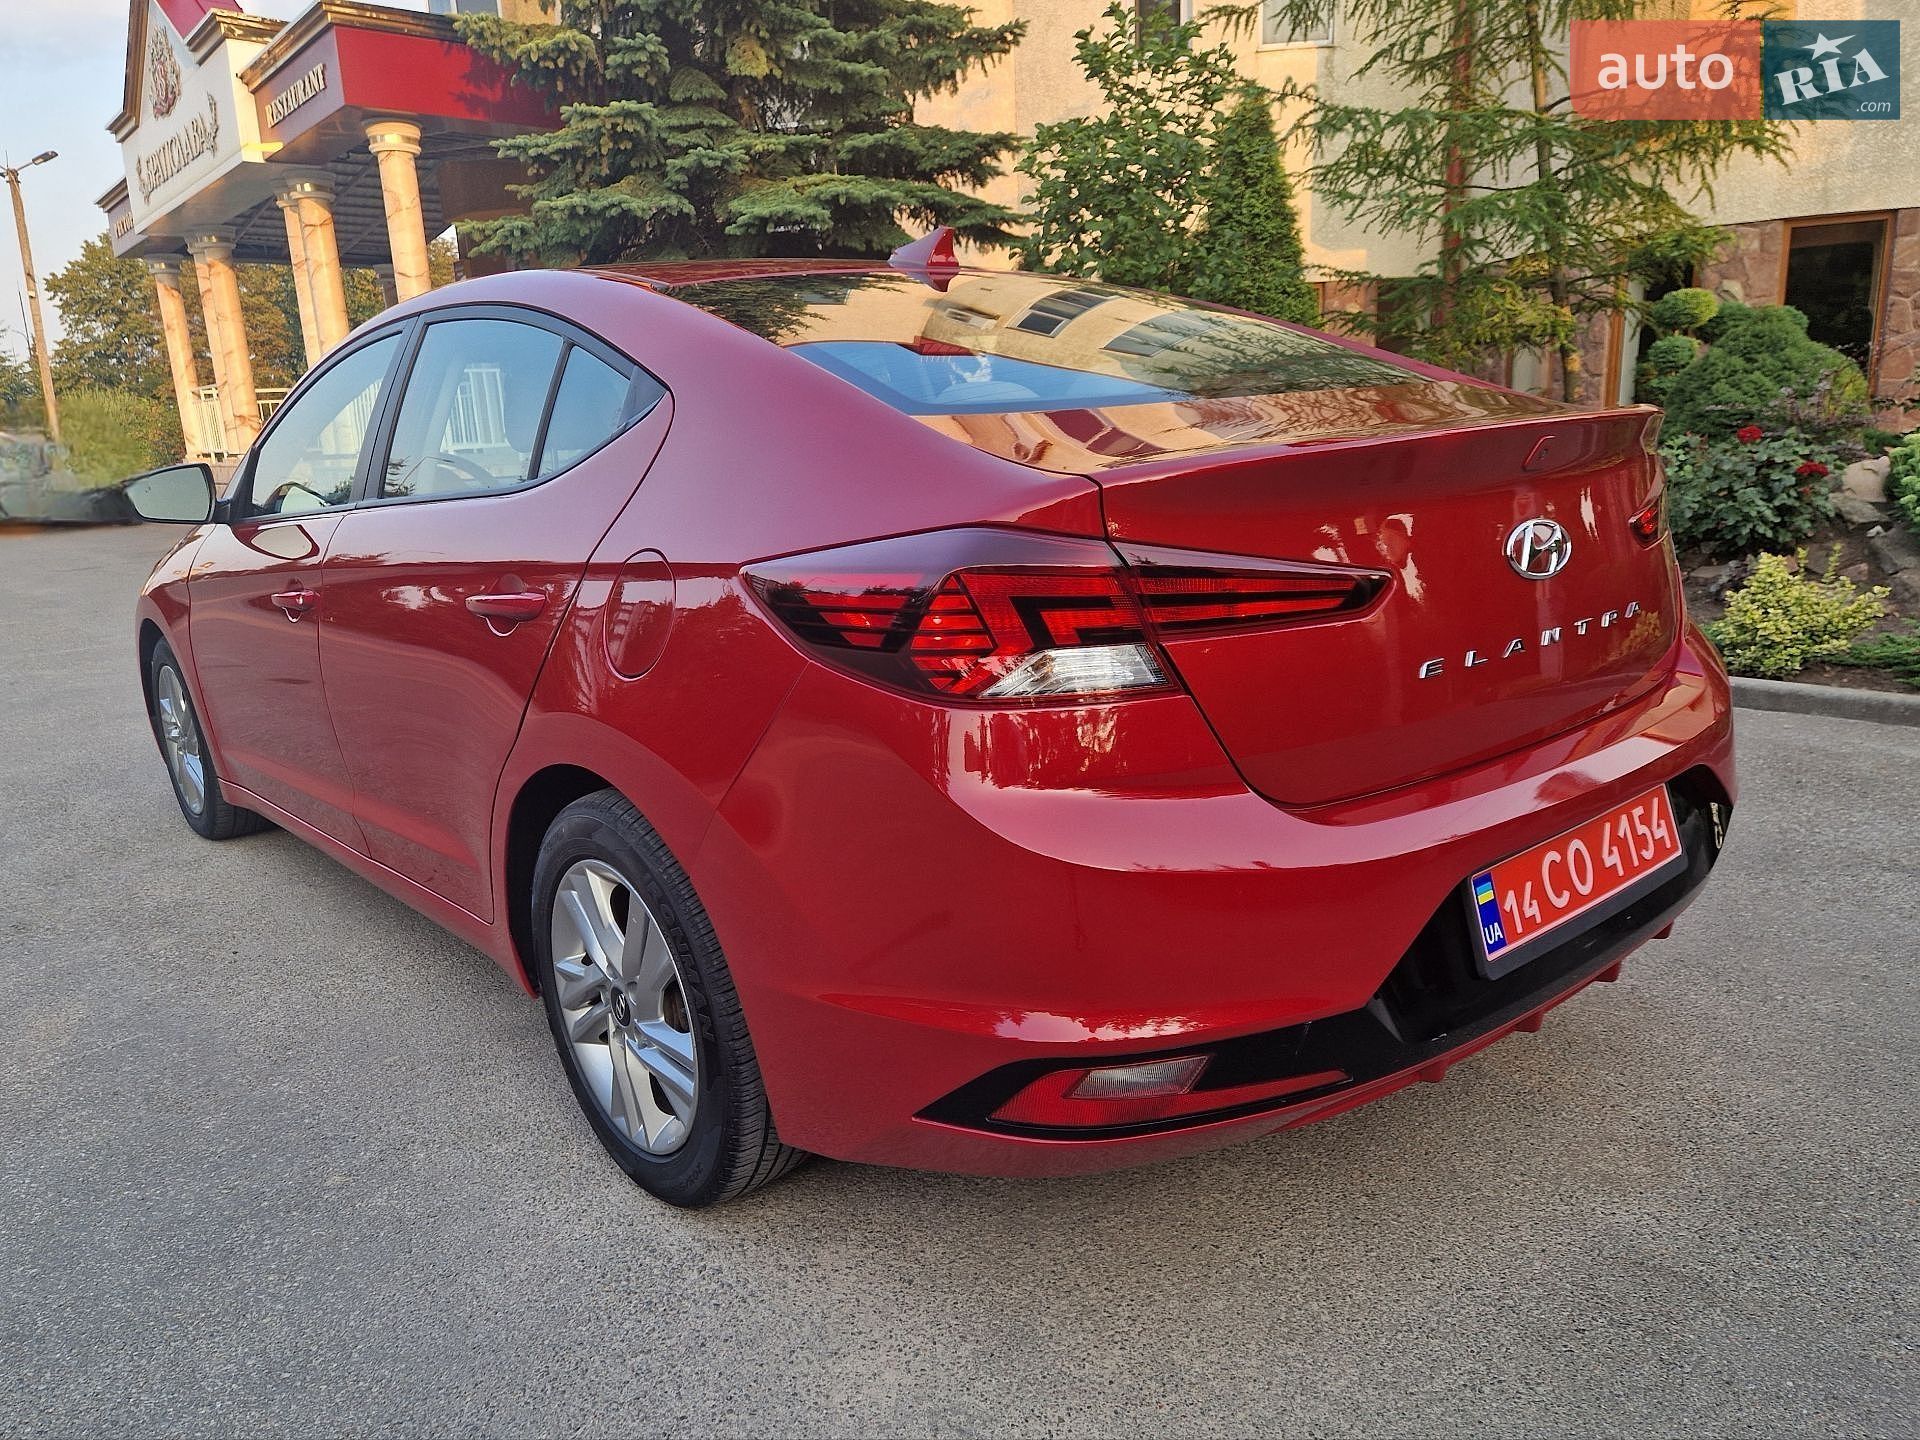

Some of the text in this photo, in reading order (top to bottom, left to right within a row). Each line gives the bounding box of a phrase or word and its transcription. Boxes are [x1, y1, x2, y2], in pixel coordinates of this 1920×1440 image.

[265, 63, 326, 128] RESTAURANT
[1419, 601, 1641, 679] ELANTRA
[1503, 796, 1672, 934] 14 CO 4154
[1484, 922, 1503, 944] UA
